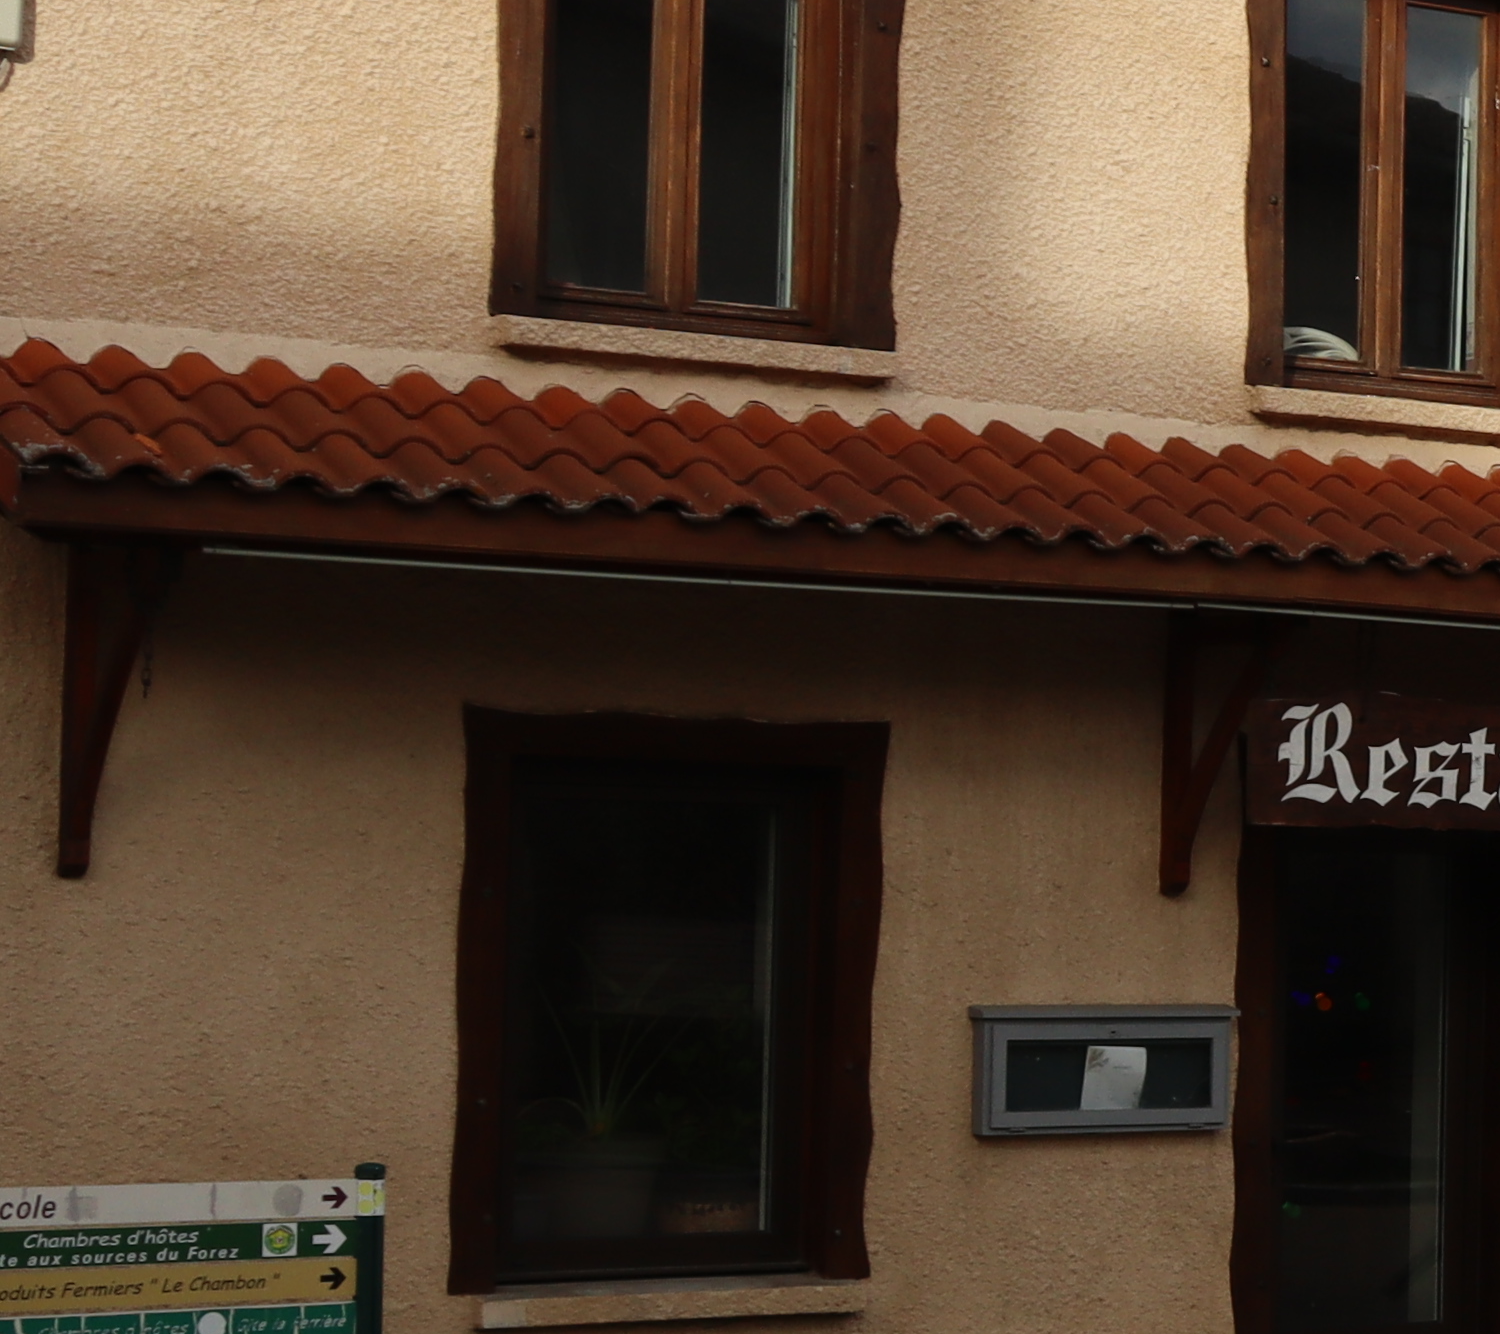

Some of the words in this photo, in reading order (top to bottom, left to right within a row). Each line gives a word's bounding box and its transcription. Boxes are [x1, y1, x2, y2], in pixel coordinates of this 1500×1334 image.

[23, 1232, 121, 1249] Chambres
[127, 1228, 199, 1245] d'hôtes
[27, 1254, 62, 1266] aux
[71, 1250, 148, 1264] sources
[156, 1248, 179, 1262] du
[187, 1246, 239, 1260] Forez
[61, 1281, 144, 1299] Fermiers
[189, 1274, 266, 1292] Chambon
